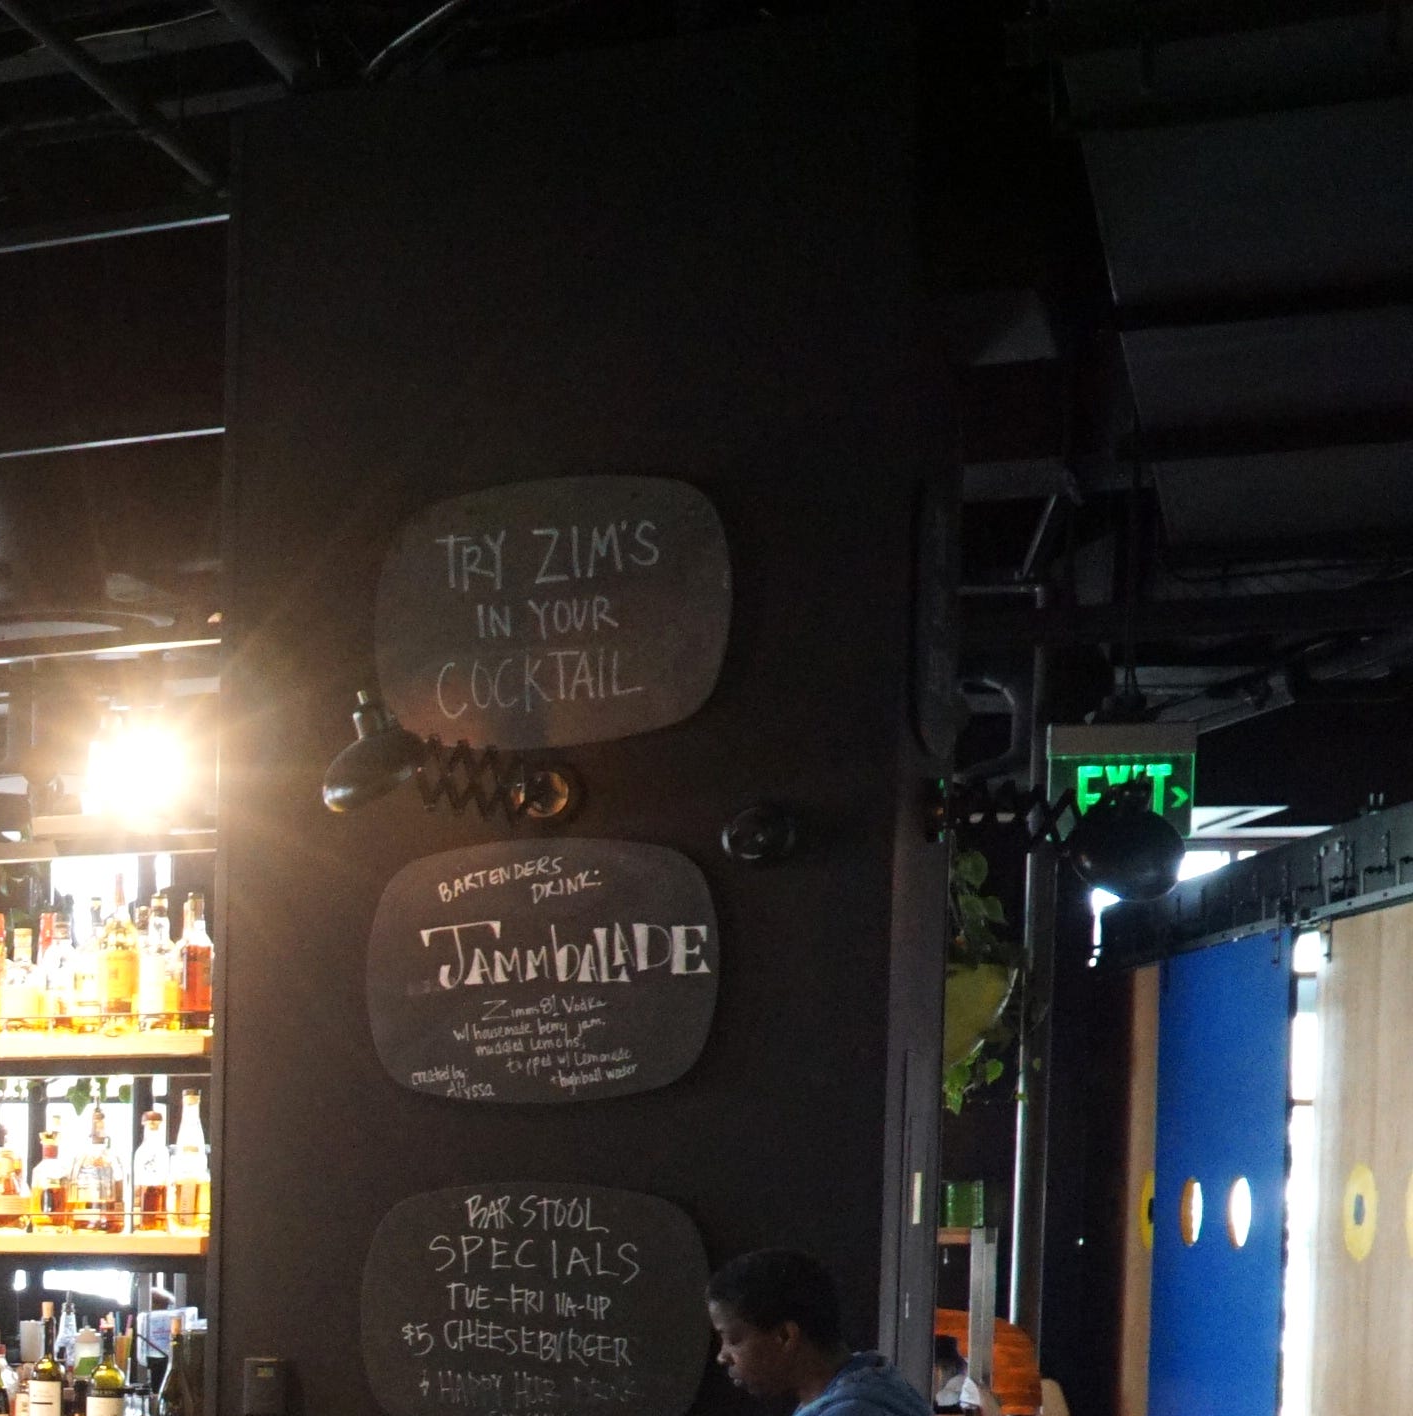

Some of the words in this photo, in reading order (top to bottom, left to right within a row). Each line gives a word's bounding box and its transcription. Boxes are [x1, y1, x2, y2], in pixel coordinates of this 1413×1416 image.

[435, 530, 506, 591] TRY
[532, 519, 660, 585] ZIM'S
[478, 603, 511, 637] IN
[529, 596, 619, 641] YOUR
[437, 650, 644, 719] COCKTAIL
[1077, 764, 1172, 816] ET
[439, 856, 564, 902] BARTENDERS
[429, 1235, 641, 1285] SPECIALS
[401, 1322, 435, 1357] $5
[443, 1319, 633, 1367] CHEESEBURGER
